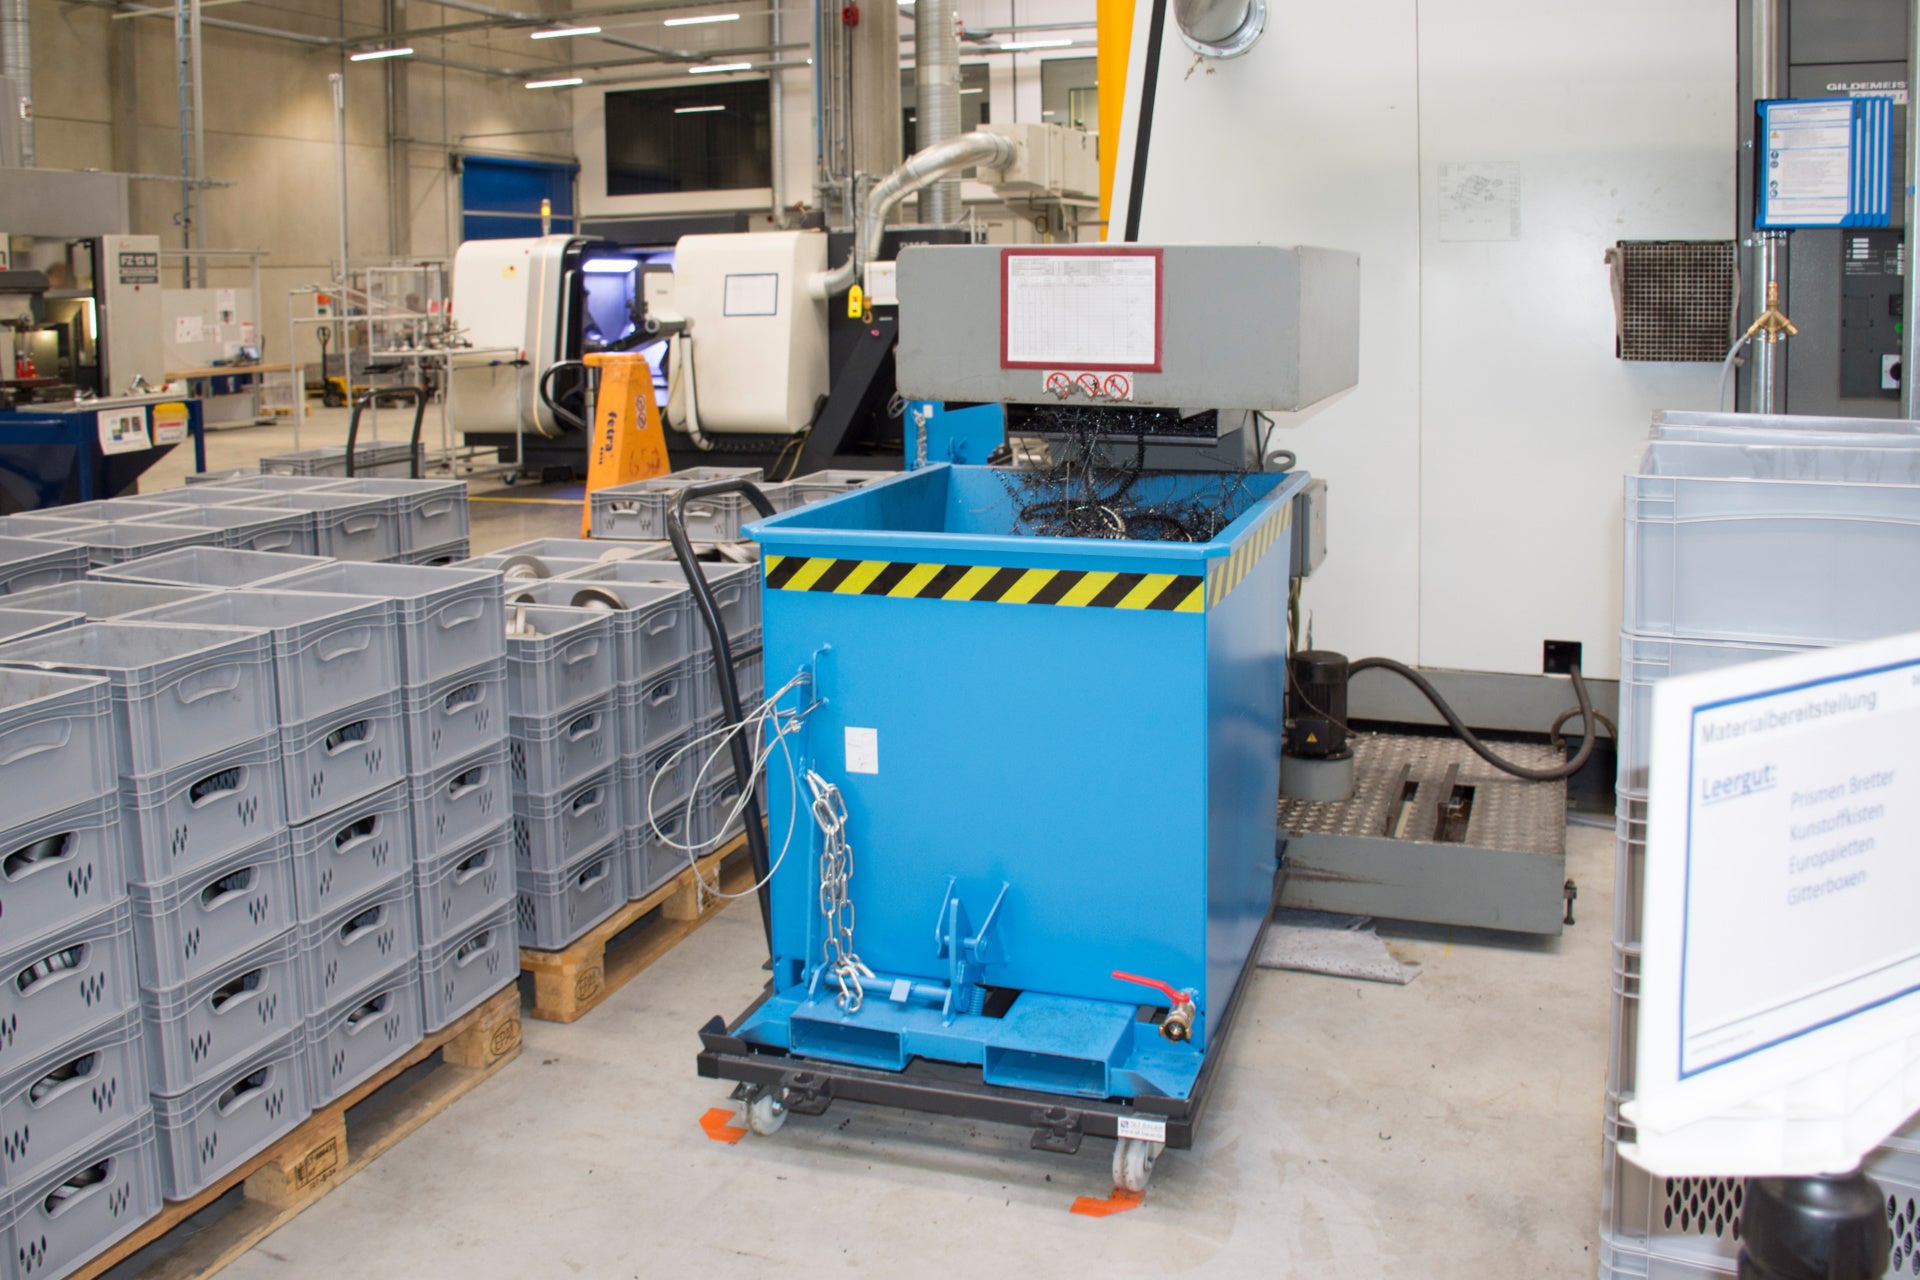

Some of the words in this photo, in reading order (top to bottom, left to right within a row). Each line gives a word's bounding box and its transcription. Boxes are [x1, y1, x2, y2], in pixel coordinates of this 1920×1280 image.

[1826, 81, 1906, 91] GILDEMEIS
[1702, 691, 1877, 743] Materialbereitstellung
[1702, 763, 1776, 801] Leergut:
[1791, 783, 1845, 809] Prismen
[1850, 770, 1896, 794] Bretter
[1789, 803, 1884, 841] Kunstoffkisten
[1788, 836, 1875, 875] Europaletten
[1787, 869, 1867, 905] Gitterboxen
